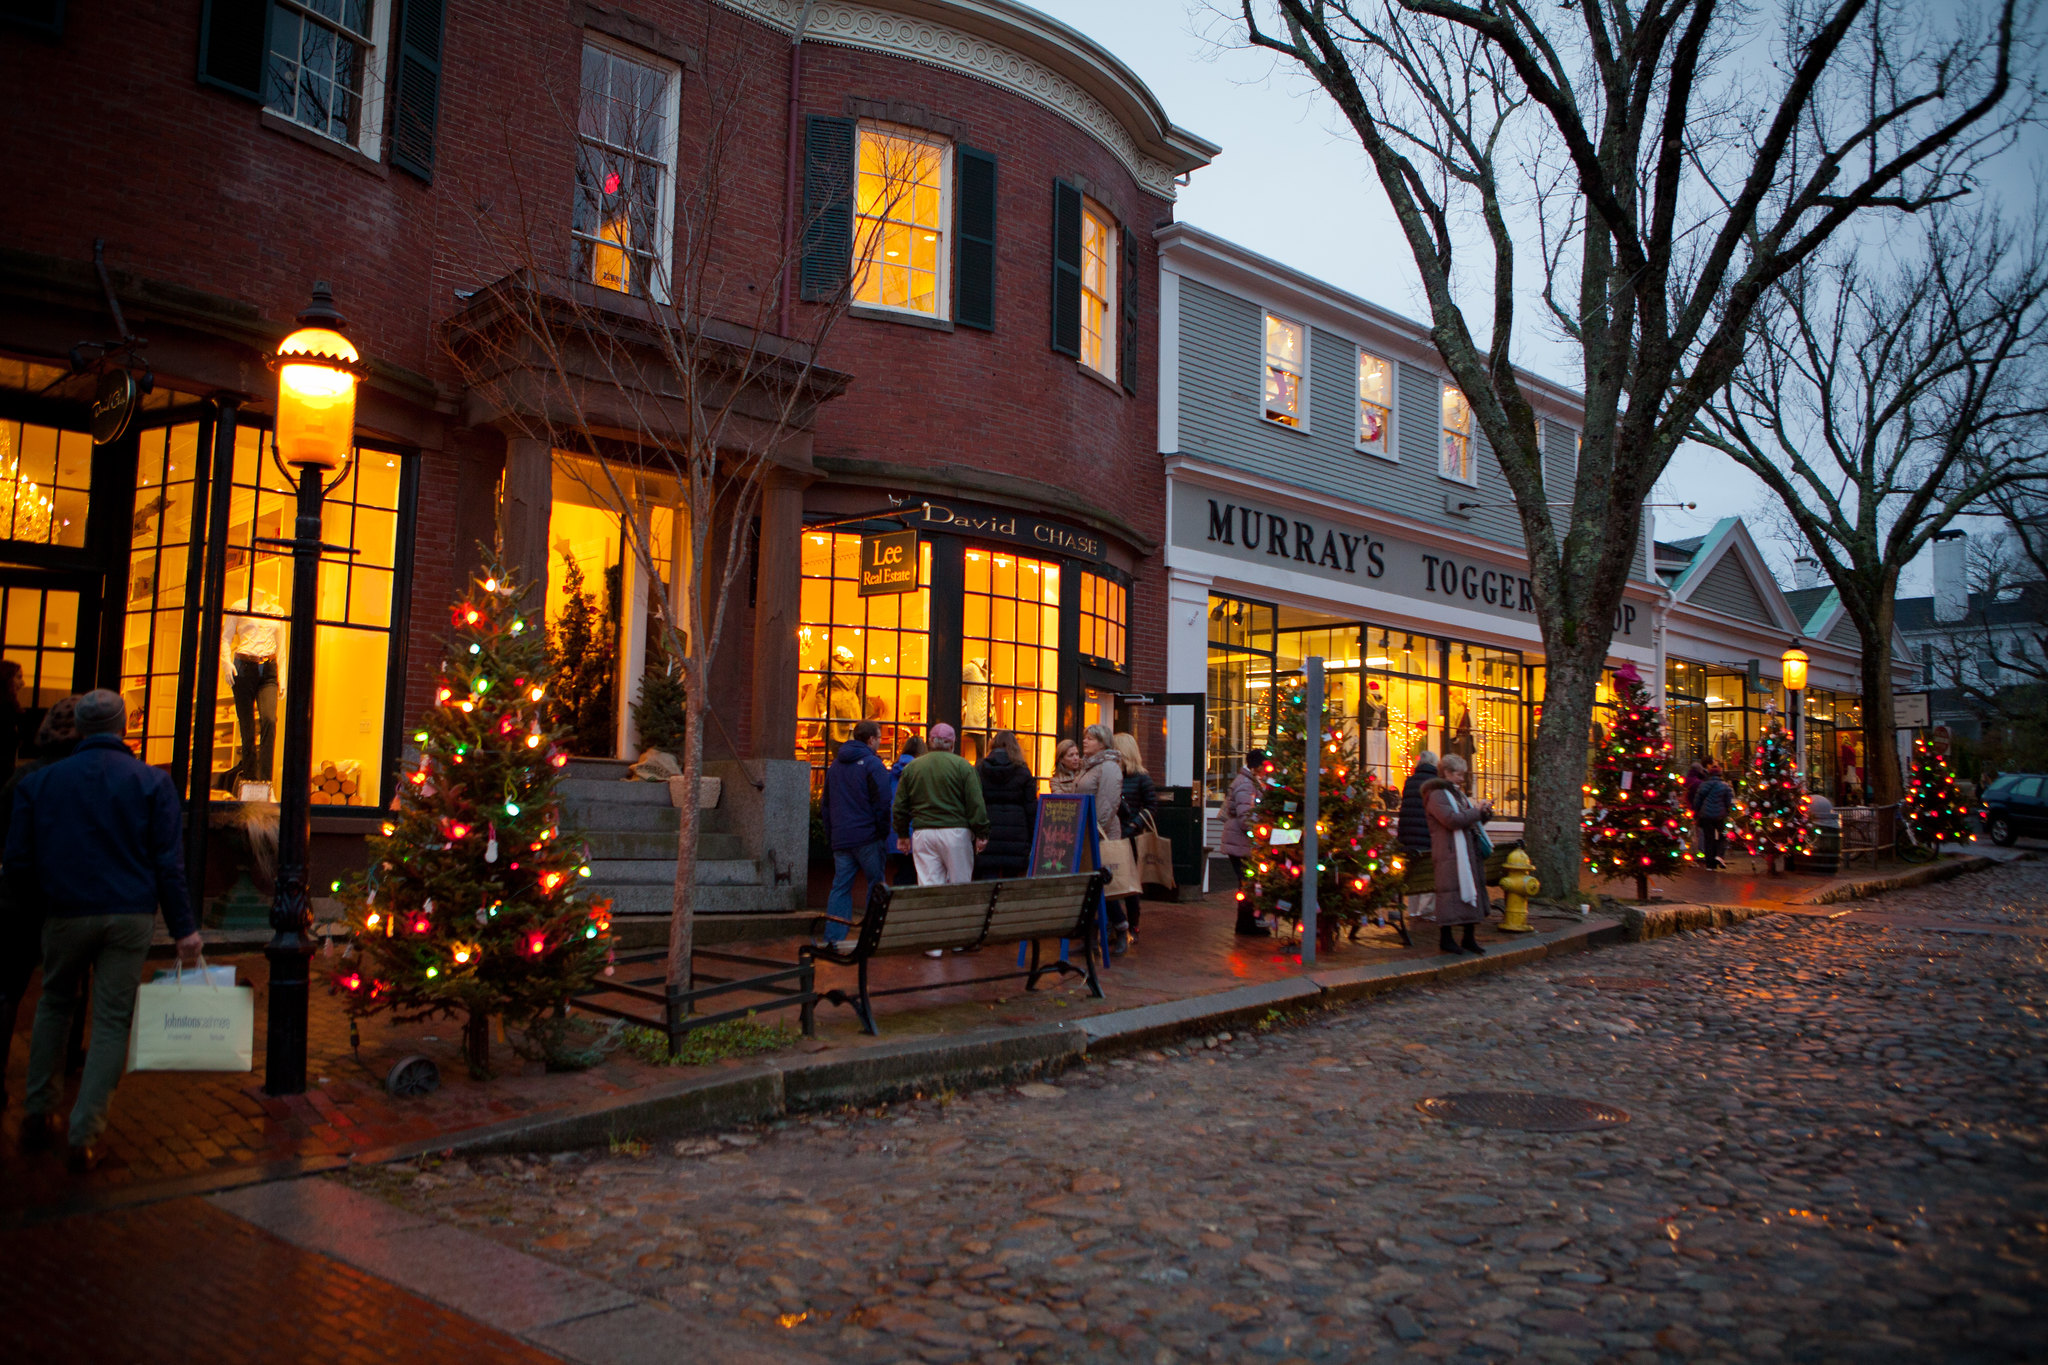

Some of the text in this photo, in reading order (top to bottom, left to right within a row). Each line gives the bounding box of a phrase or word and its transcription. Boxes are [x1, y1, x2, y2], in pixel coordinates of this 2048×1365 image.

[921, 503, 1098, 556] David CHASE
[872, 540, 903, 566] Lee
[1207, 499, 1385, 578] MURRAY'S
[1422, 554, 1537, 613] TOGGER
[863, 567, 911, 586] Real Estate
